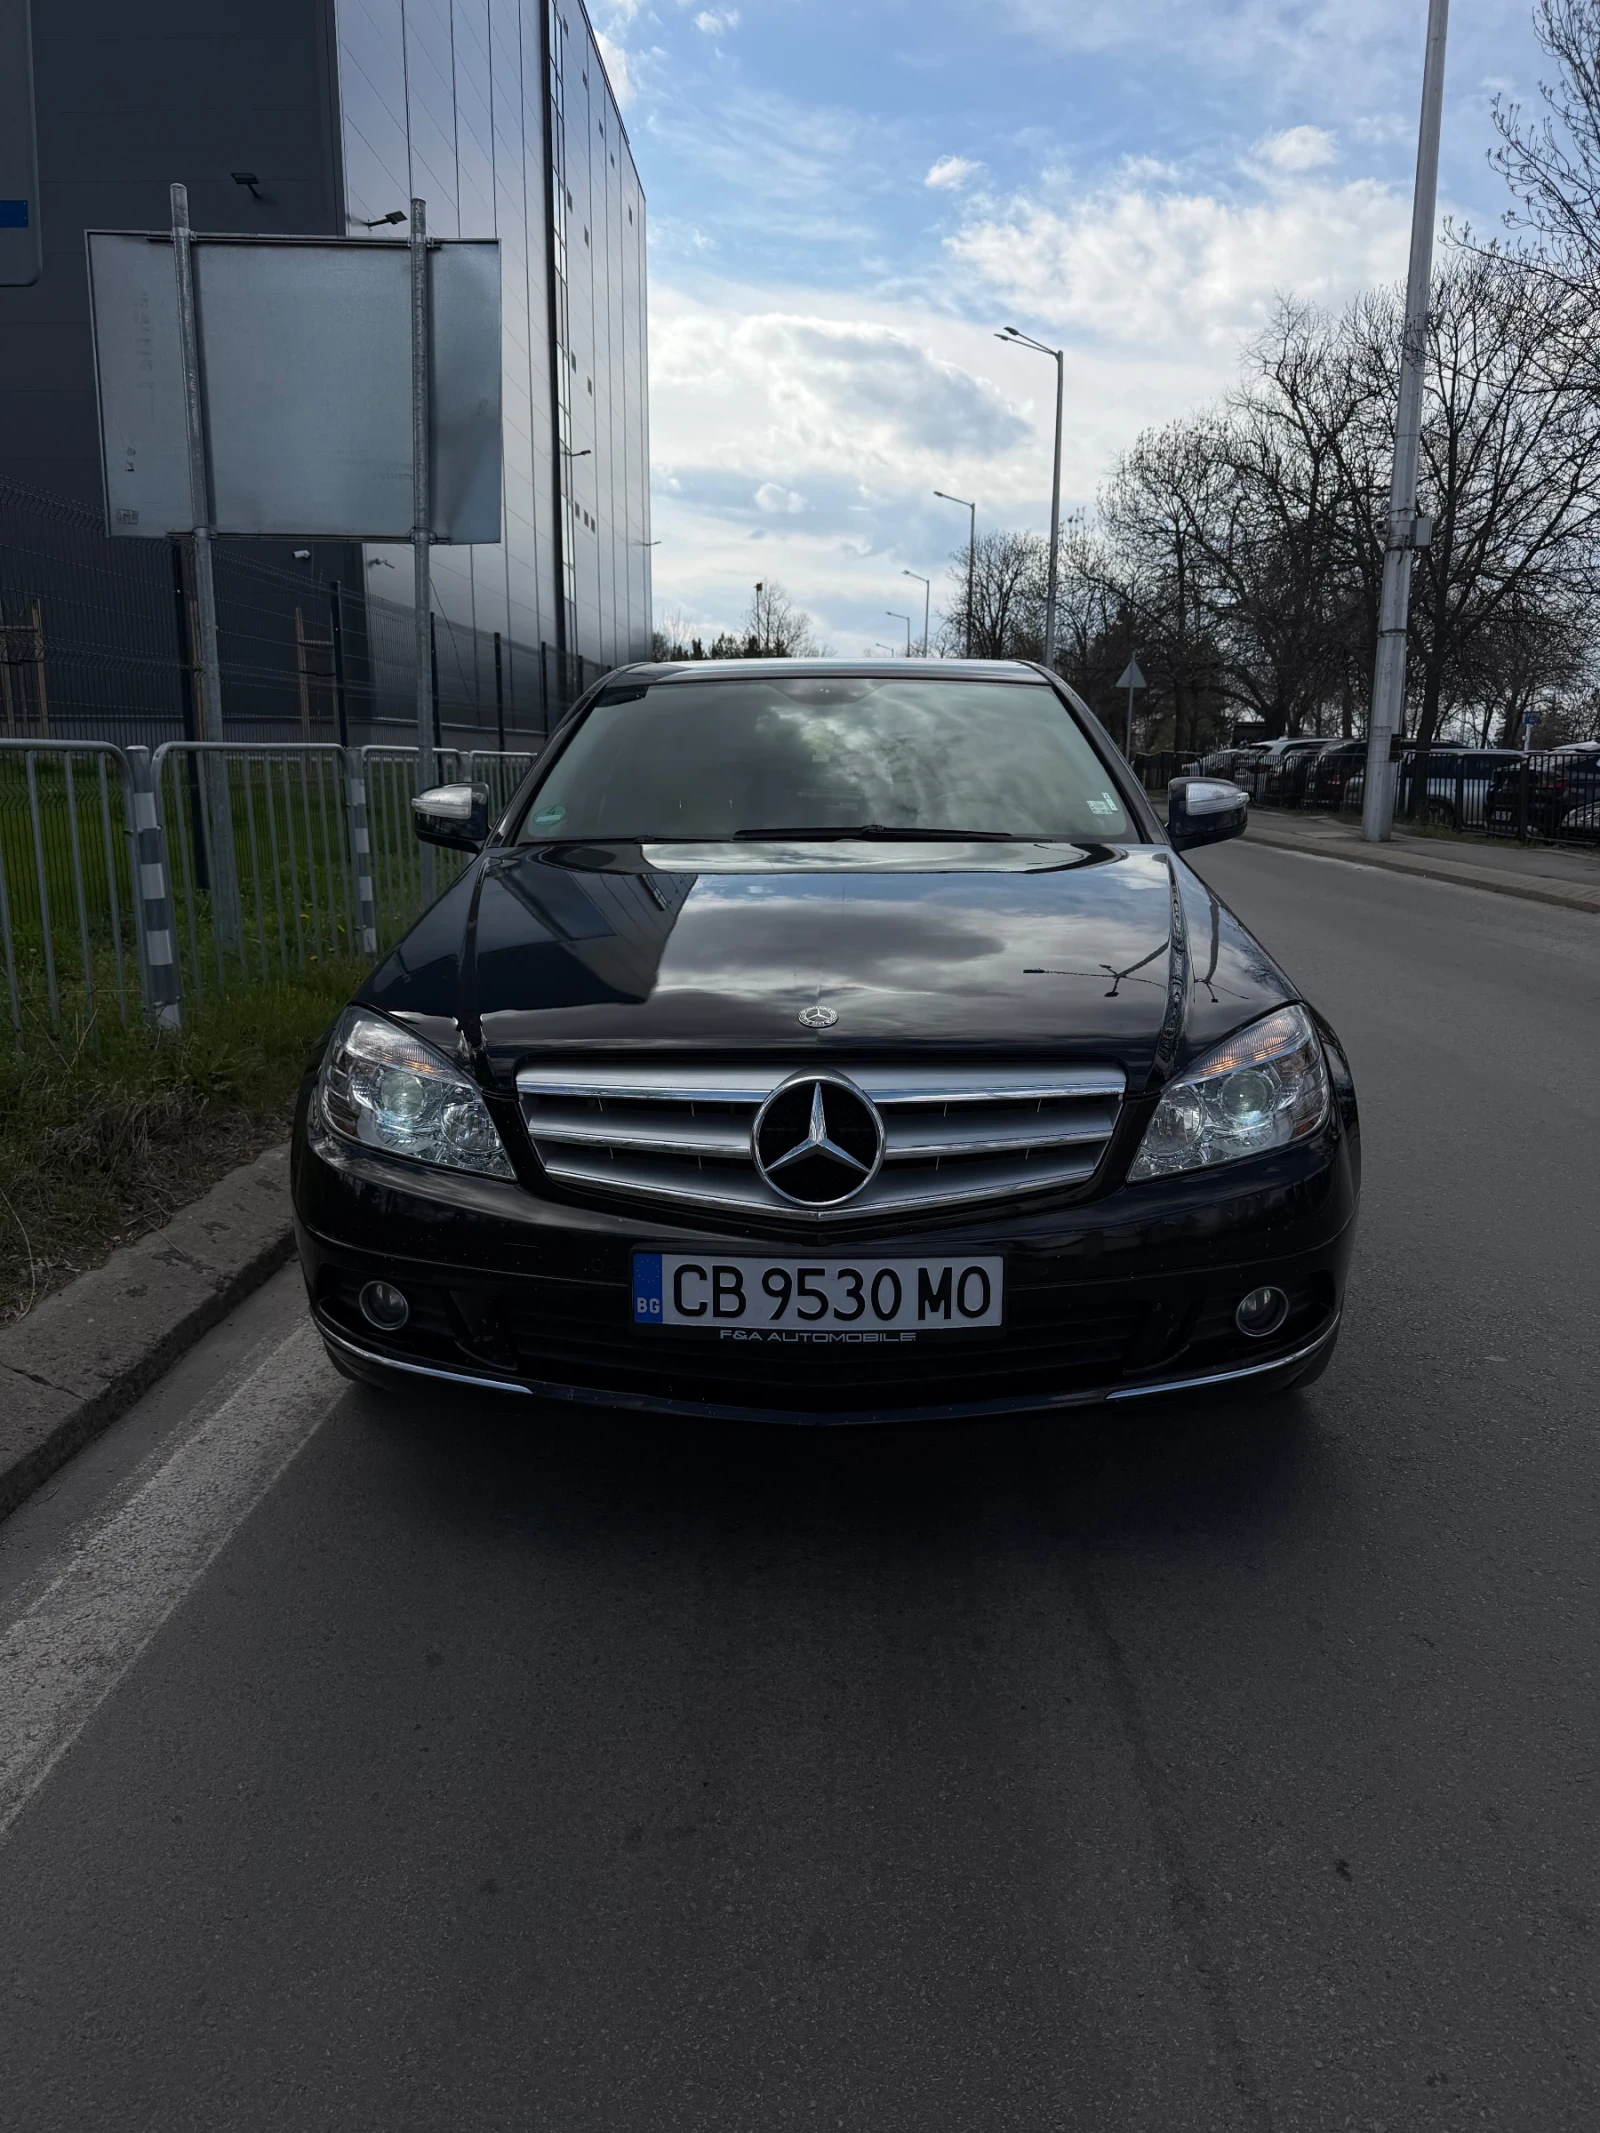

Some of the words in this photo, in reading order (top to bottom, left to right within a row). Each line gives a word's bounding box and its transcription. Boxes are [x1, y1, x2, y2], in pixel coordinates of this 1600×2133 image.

[673, 1263, 747, 1318] CB
[761, 1267, 902, 1322] 9530
[917, 1265, 992, 1321] MO
[637, 1297, 660, 1314] BG
[719, 1329, 763, 1341] F&A
[767, 1331, 917, 1343] AUTOMOBILE
